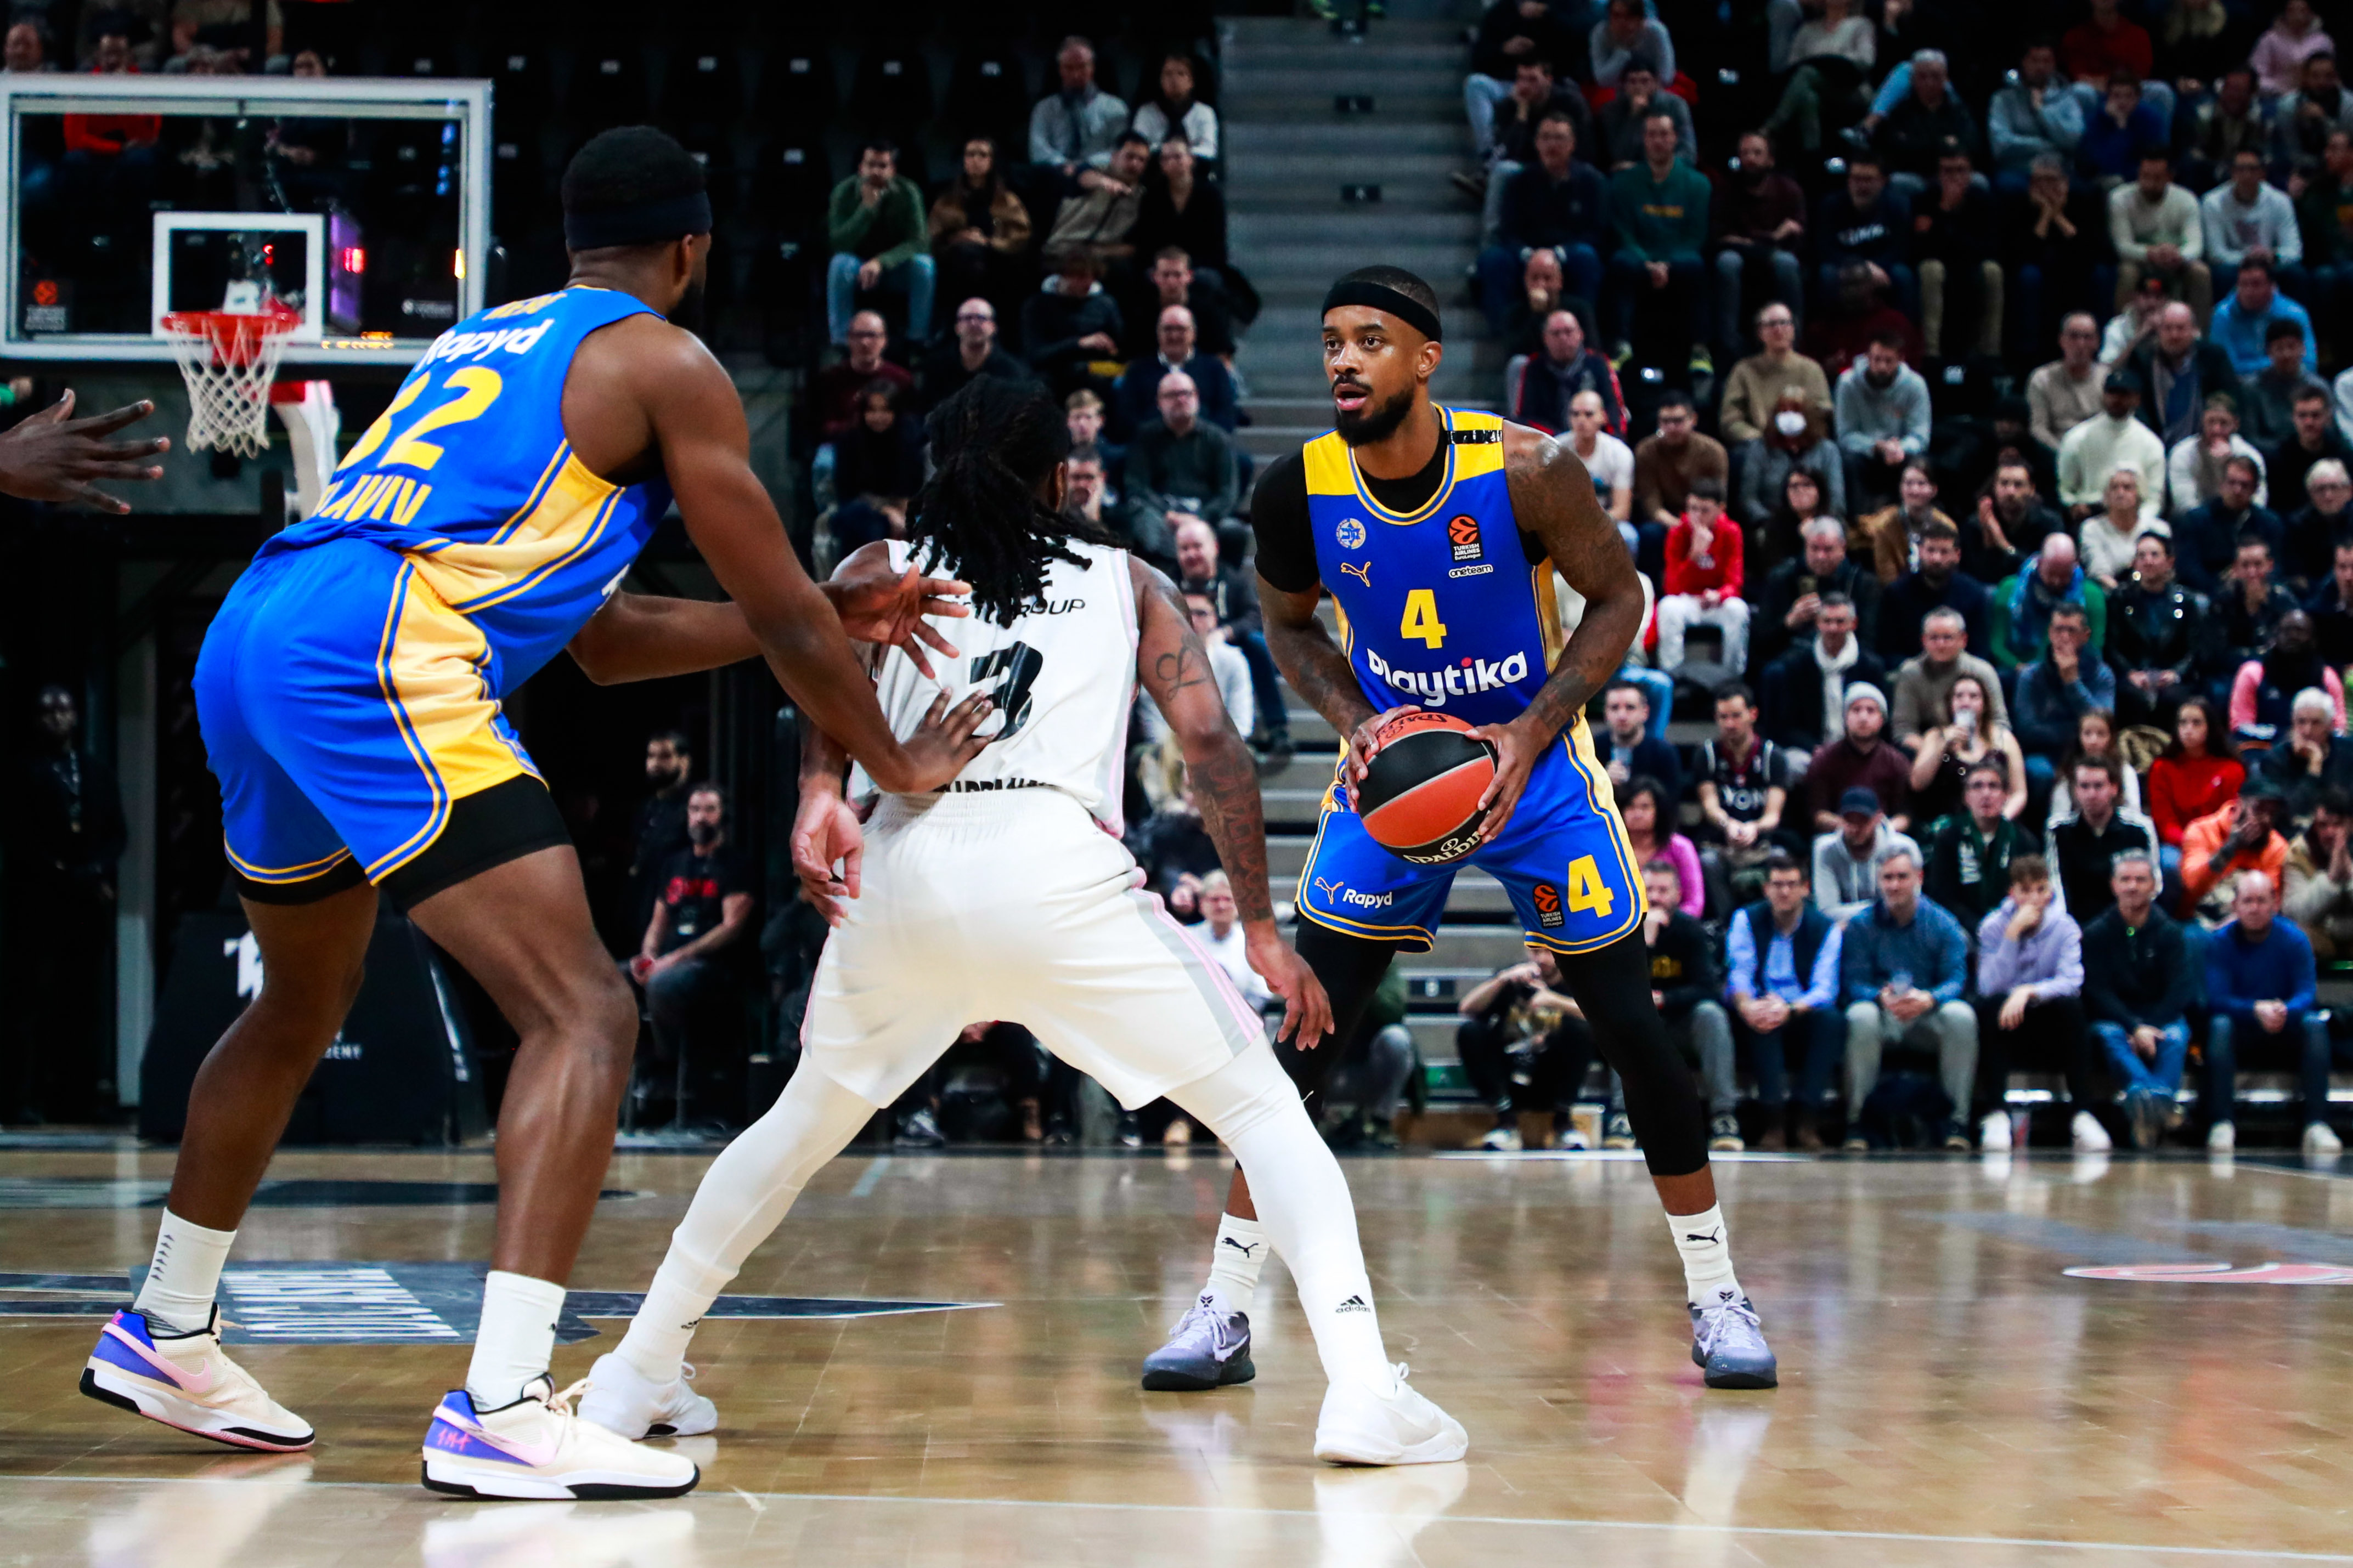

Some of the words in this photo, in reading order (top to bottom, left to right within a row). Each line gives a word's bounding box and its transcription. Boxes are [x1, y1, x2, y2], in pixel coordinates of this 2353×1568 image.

[415, 319, 554, 372] Rapyd
[1453, 543, 1480, 551] TURKISH
[1450, 565, 1492, 577] oneteam
[1401, 589, 1447, 649] 4
[1342, 888, 1392, 908] Rapyd
[1568, 854, 1615, 918] 4
[221, 1269, 421, 1304] ASVEL
[234, 1305, 460, 1337] LDLC
[1335, 1305, 1370, 1313] adidas
